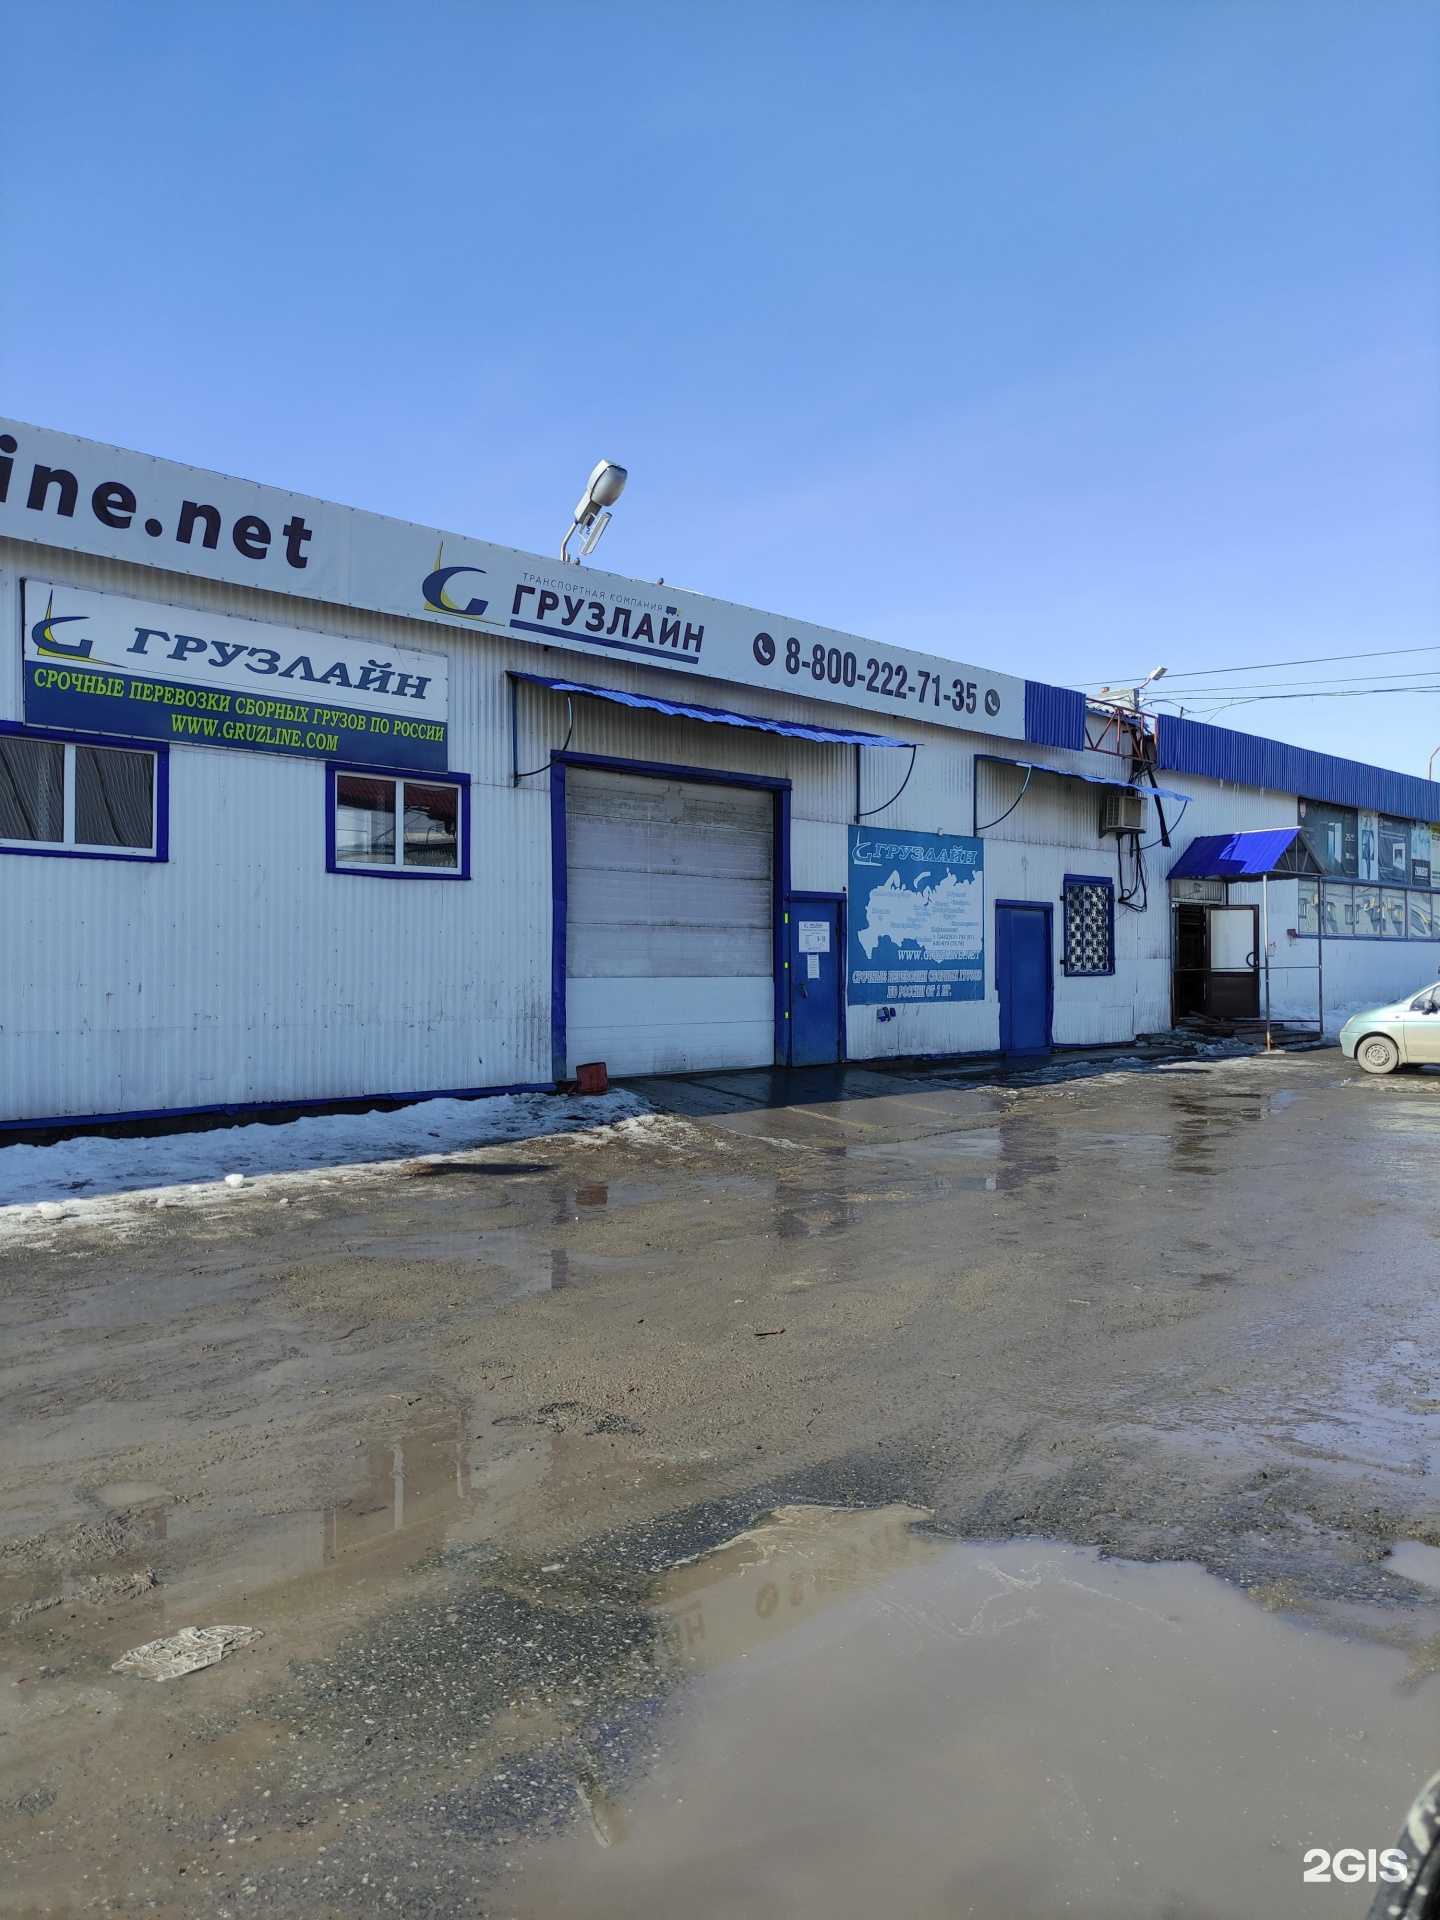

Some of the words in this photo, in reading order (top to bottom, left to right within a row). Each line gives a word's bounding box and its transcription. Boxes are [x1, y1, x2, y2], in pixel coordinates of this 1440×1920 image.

[0, 434, 313, 569] ine.net
[523, 572, 605, 600] ТРАНСПОРТНАЯ
[610, 592, 663, 611] КОМПАНИЯ
[126, 627, 432, 700] ГРУЗЛАЙН
[785, 637, 977, 714] 8-800-222-71-35
[34, 668, 125, 697] СРОЧНЫЕ
[129, 681, 231, 713] ПЕРЕВОЗКИ
[235, 696, 310, 723] СБОРНЫХ
[312, 708, 366, 731] ГРУЗОВ
[370, 717, 390, 734] ПО
[393, 720, 445, 742] РОССИИ
[171, 714, 339, 751] WWW.GRUZLINE.COM
[873, 842, 977, 865] ГРУЗЛАЙН
